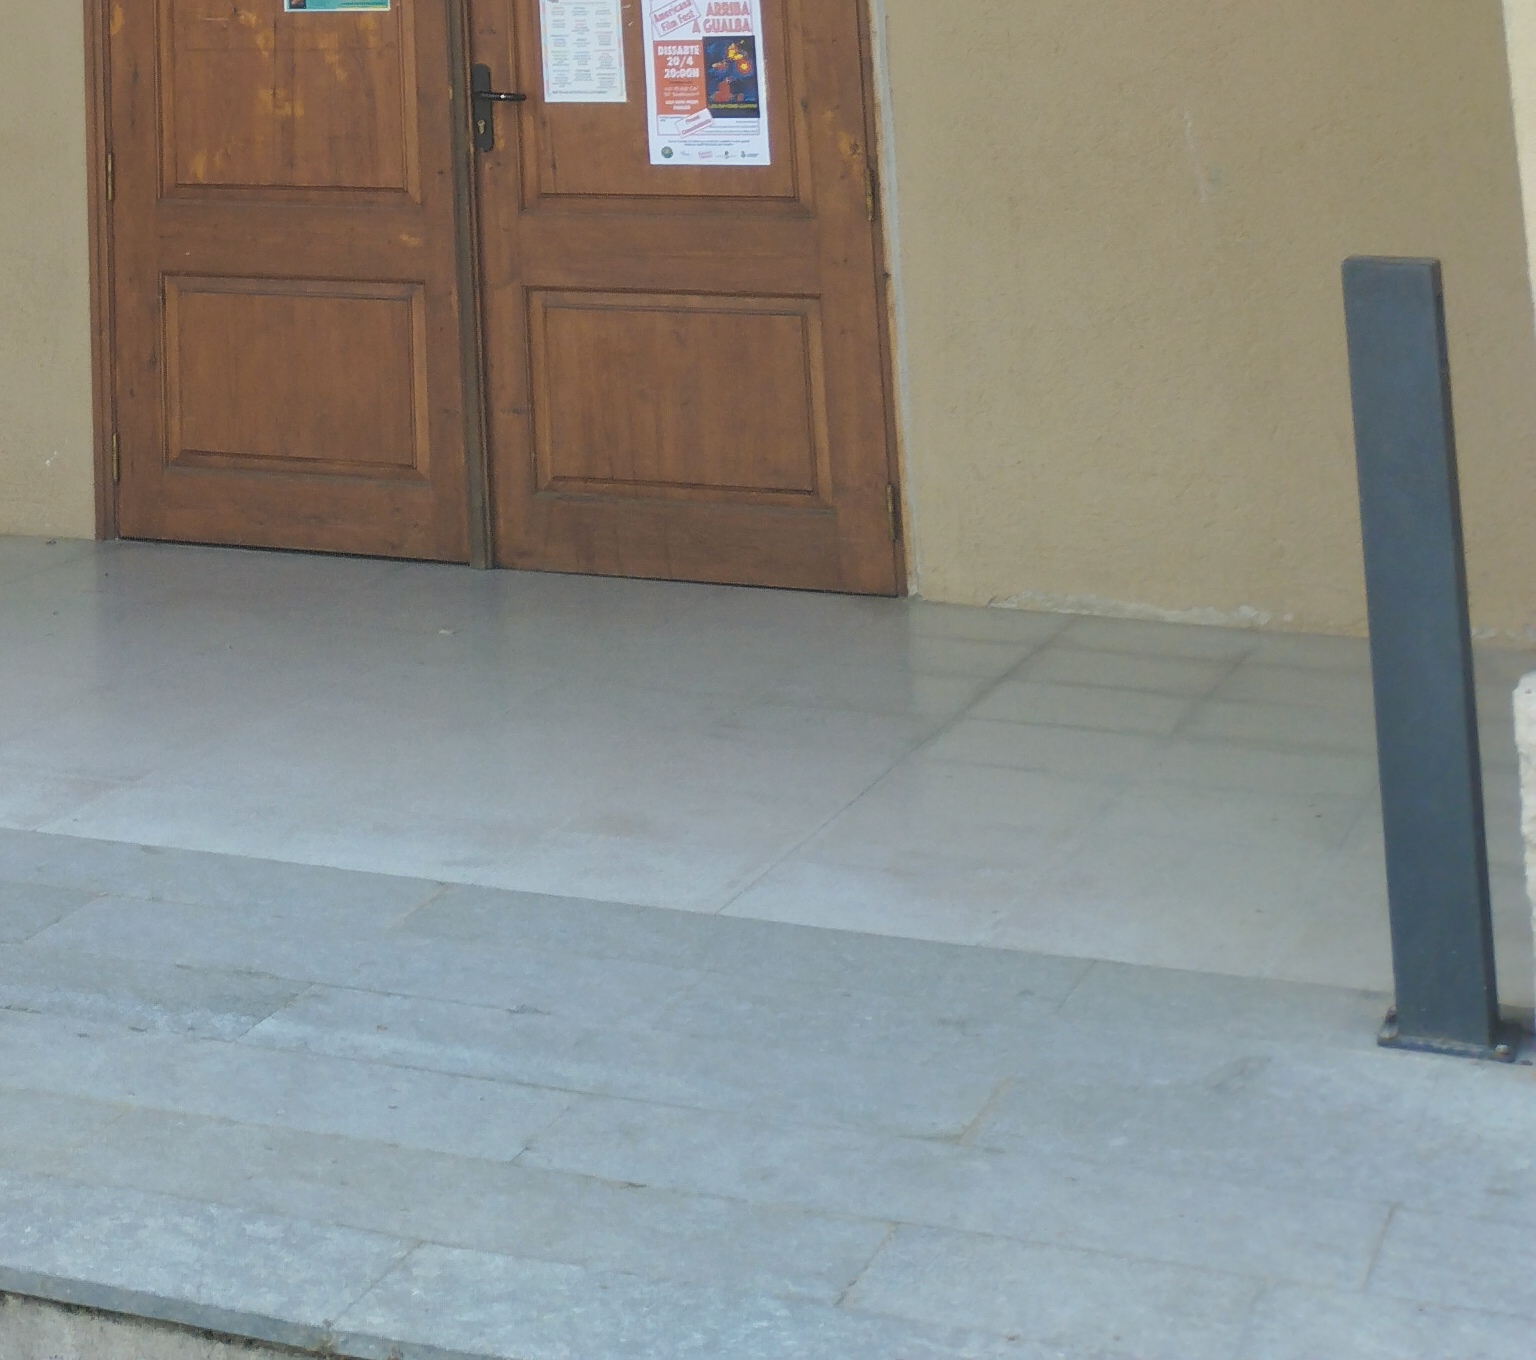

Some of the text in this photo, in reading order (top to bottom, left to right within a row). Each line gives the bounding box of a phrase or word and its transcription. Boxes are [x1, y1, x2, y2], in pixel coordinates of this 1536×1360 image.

[706, 1, 750, 16] ARRIBA
[704, 18, 752, 33] GUALBA
[657, 45, 700, 55] DISSABTE
[666, 56, 694, 68] 20/4
